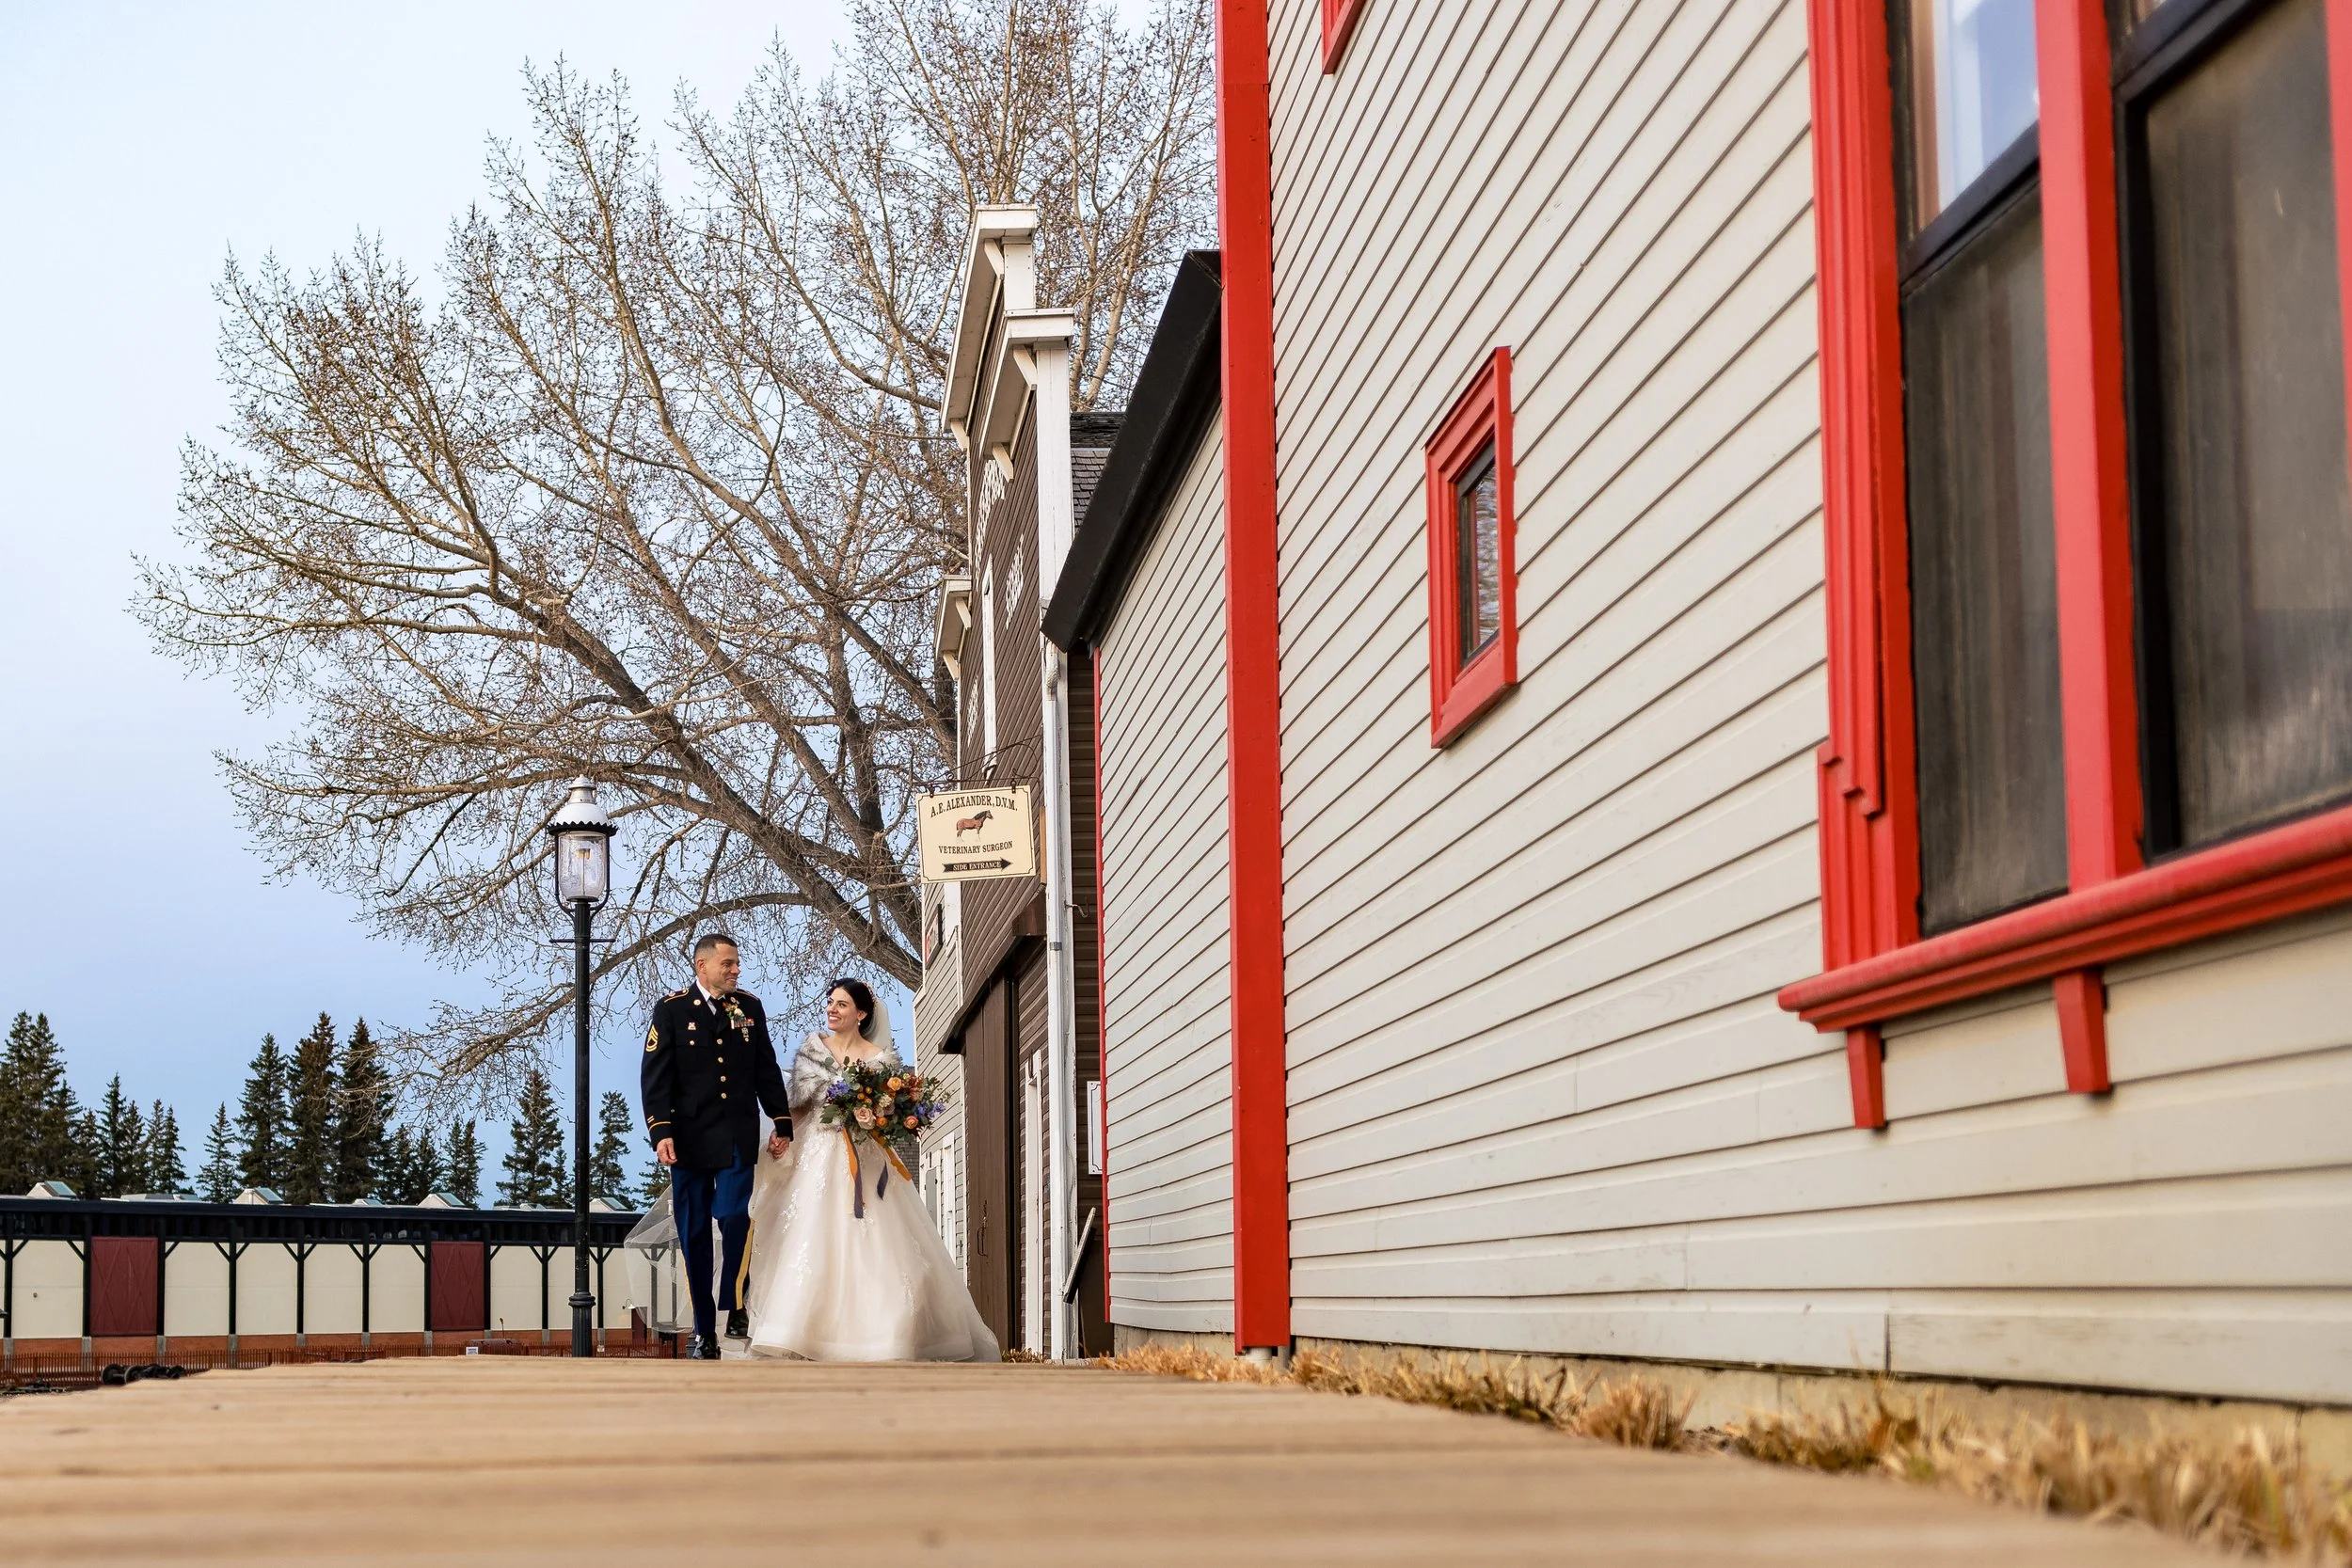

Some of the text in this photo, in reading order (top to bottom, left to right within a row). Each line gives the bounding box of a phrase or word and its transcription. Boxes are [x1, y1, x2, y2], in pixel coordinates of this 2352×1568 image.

[946, 795, 994, 811] ALEXANDER,
[995, 796, 1017, 811] D.V.M.
[938, 841, 1012, 854] VETERINARY SURGEON
[969, 862, 1002, 870] ENTRANCE
